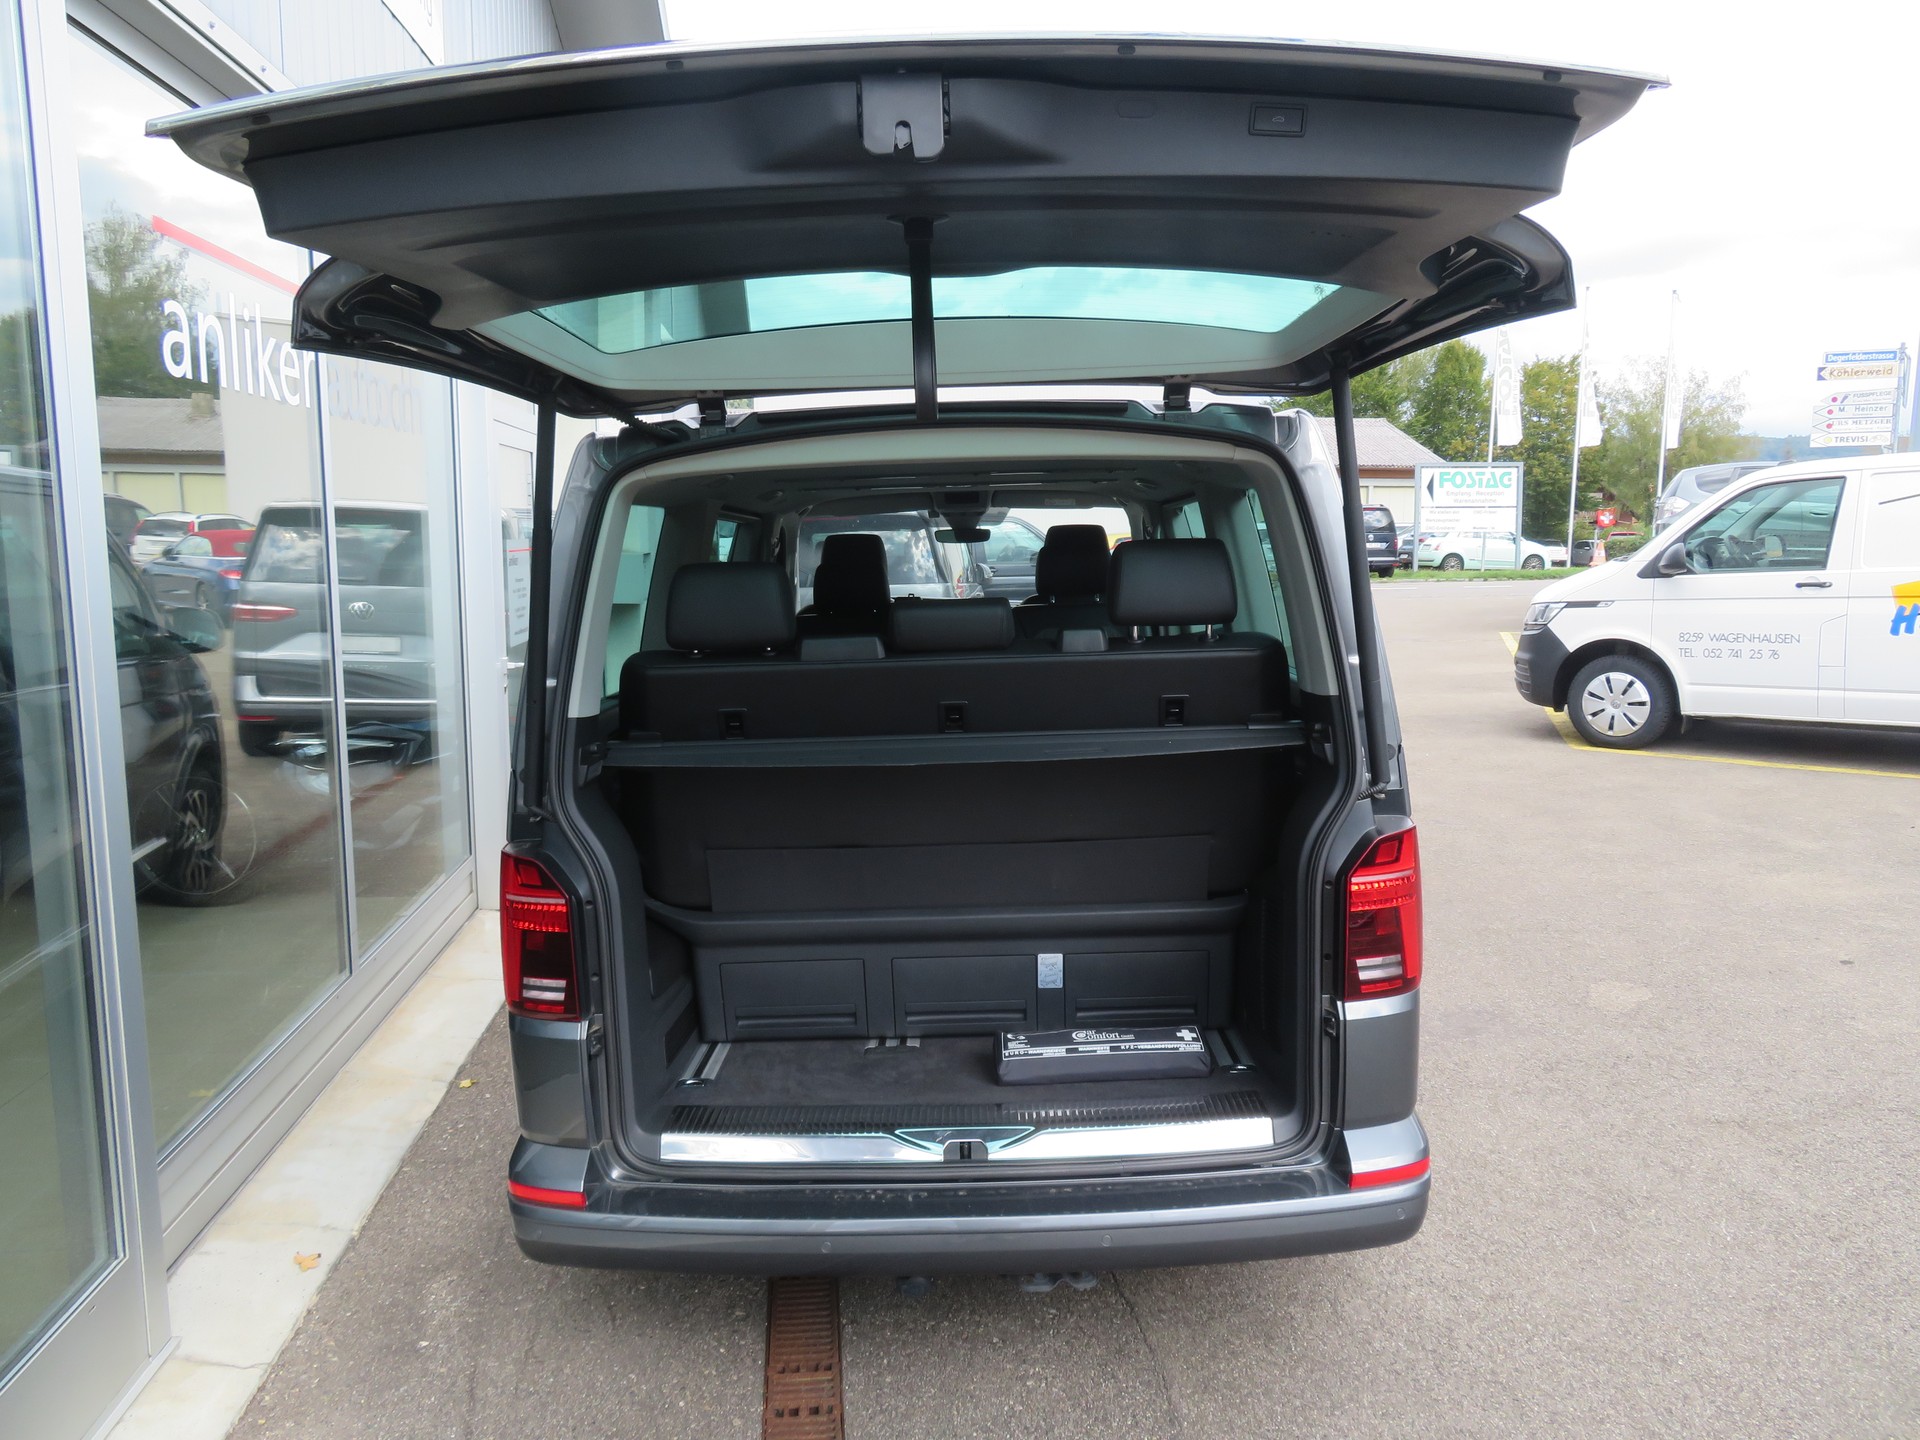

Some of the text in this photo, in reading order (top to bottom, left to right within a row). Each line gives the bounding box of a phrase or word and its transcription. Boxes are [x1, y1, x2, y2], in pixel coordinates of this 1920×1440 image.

[161, 292, 318, 408] anliker
[1439, 471, 1512, 489] FOSTAC
[1678, 632, 1801, 644] 8259 WAGENHAUSEN
[1678, 647, 1780, 660] TEL. 052 741 25 76
